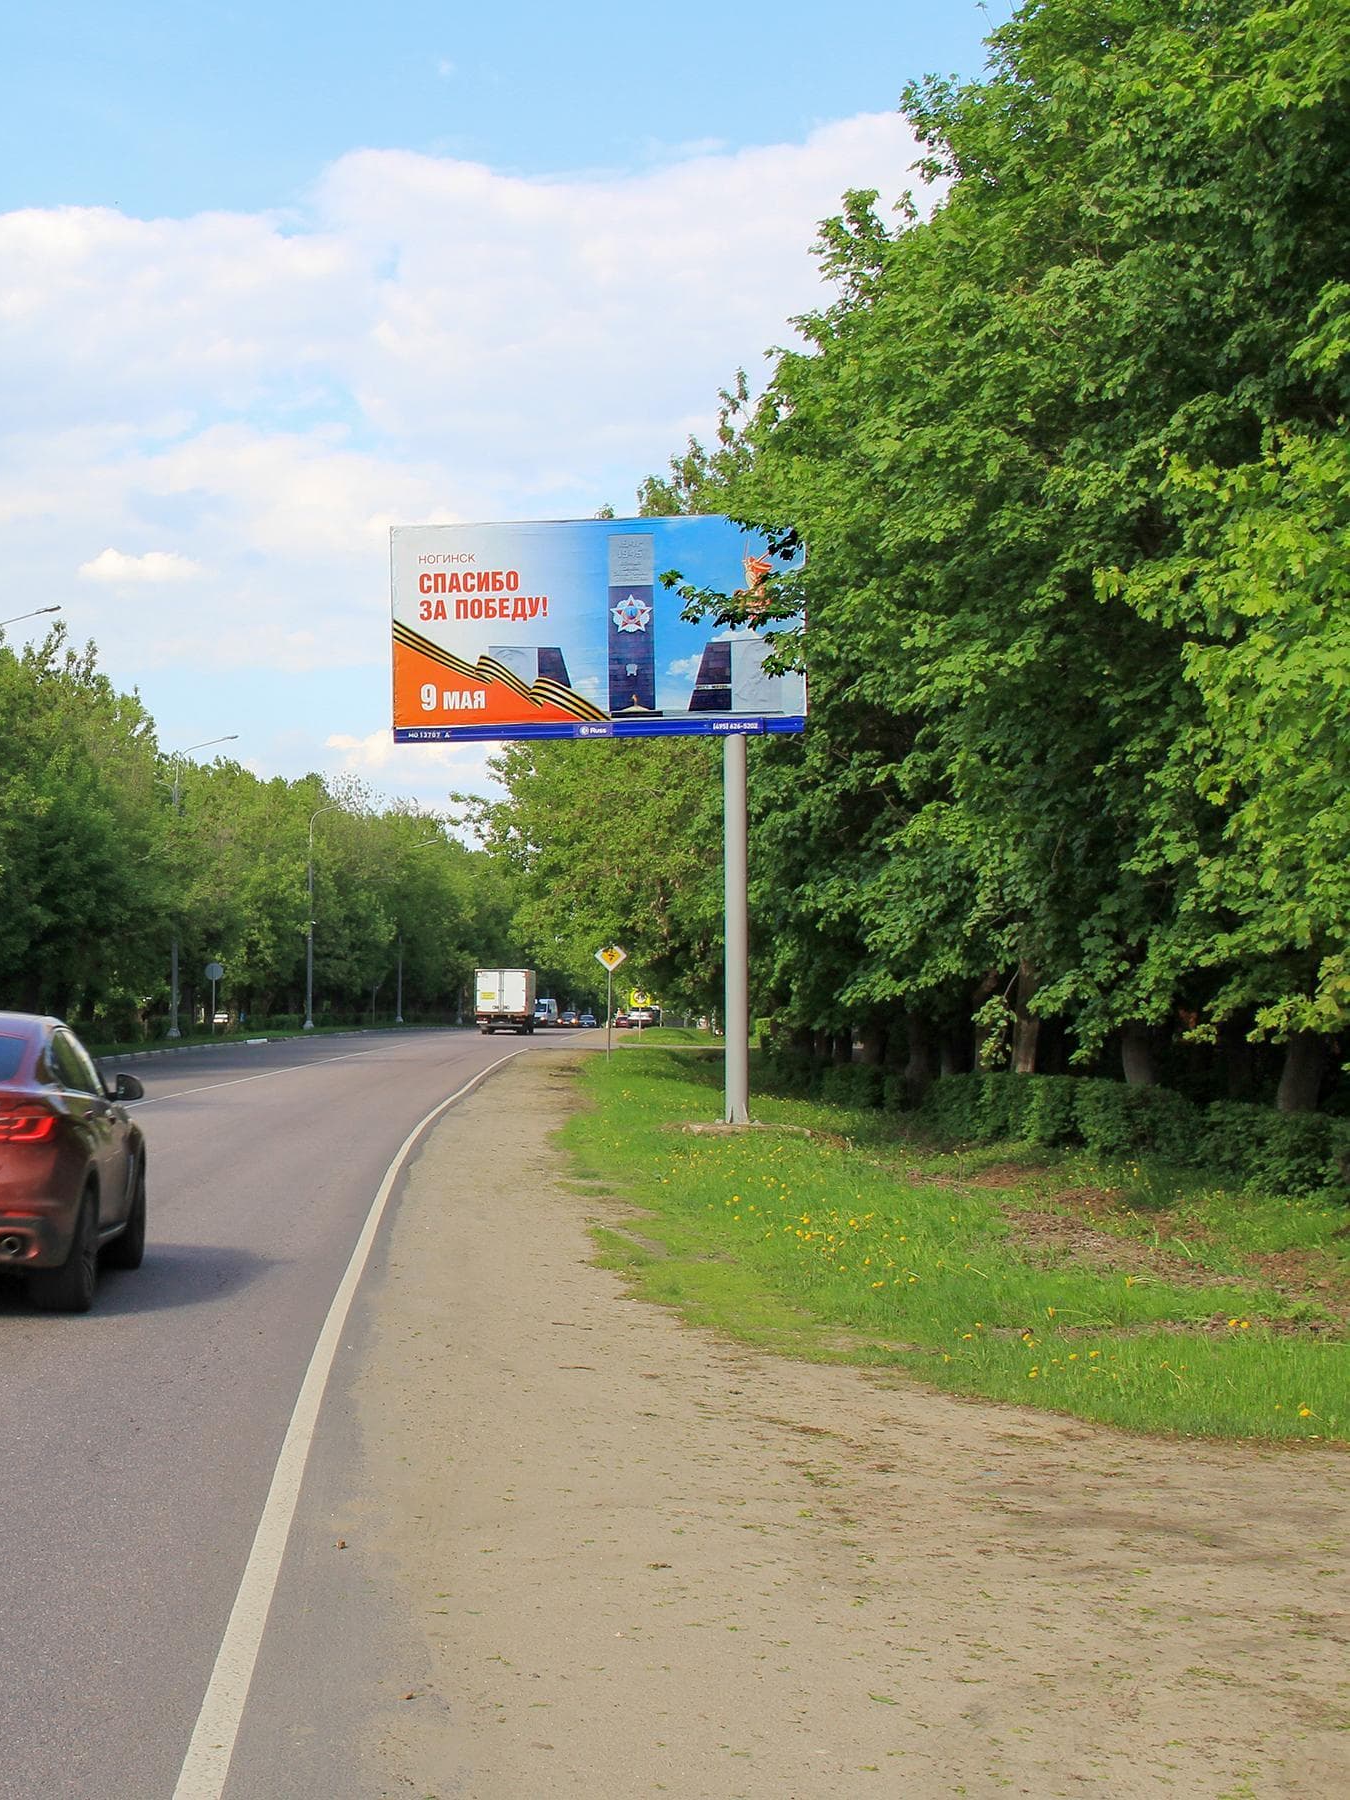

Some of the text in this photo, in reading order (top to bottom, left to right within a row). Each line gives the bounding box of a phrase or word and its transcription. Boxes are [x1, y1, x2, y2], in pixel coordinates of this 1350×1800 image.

[418, 553, 476, 565] НОГИНСК
[419, 570, 519, 594] СПАСИБО
[419, 596, 548, 621] ЗА ПОБЕДУ!
[420, 683, 486, 711] 9 МАЯ
[589, 727, 607, 735] Russ
